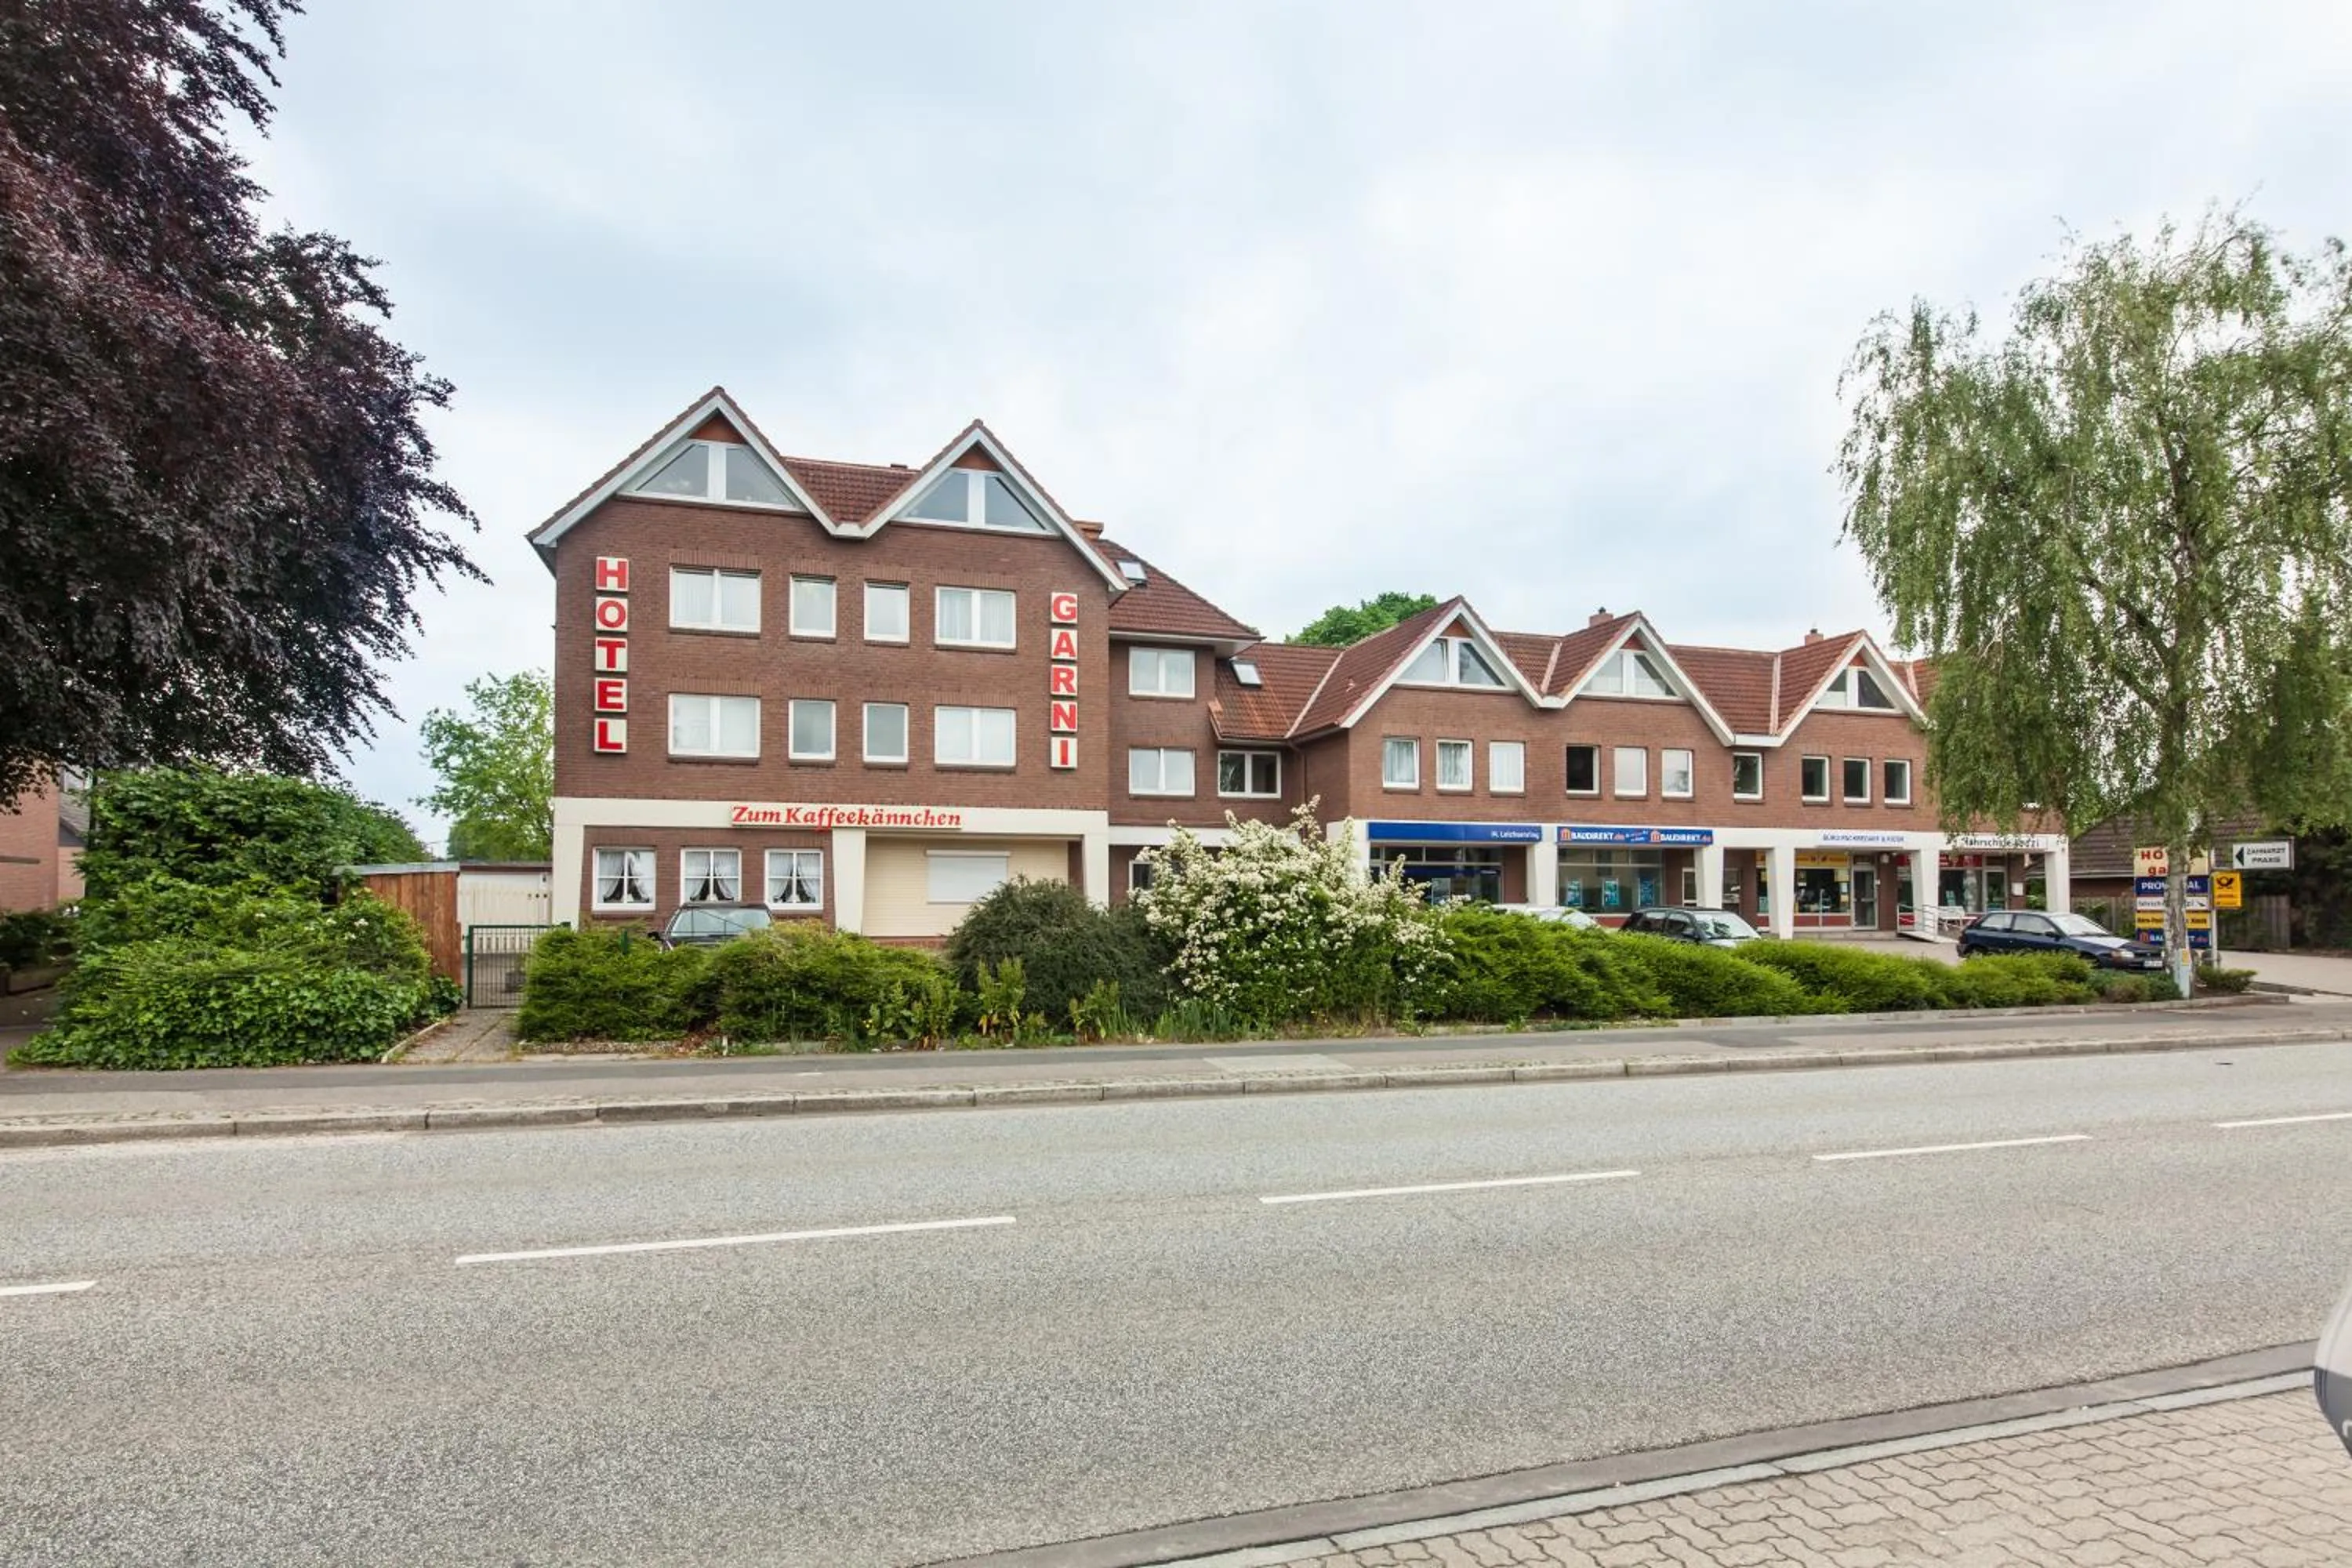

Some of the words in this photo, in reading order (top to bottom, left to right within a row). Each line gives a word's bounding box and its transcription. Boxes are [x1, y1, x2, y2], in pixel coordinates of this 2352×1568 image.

[597, 558, 628, 750] HOTEL
[1052, 594, 1076, 766] GARNI
[733, 806, 780, 823] Zum
[786, 806, 961, 832] Kaffeekännchen
